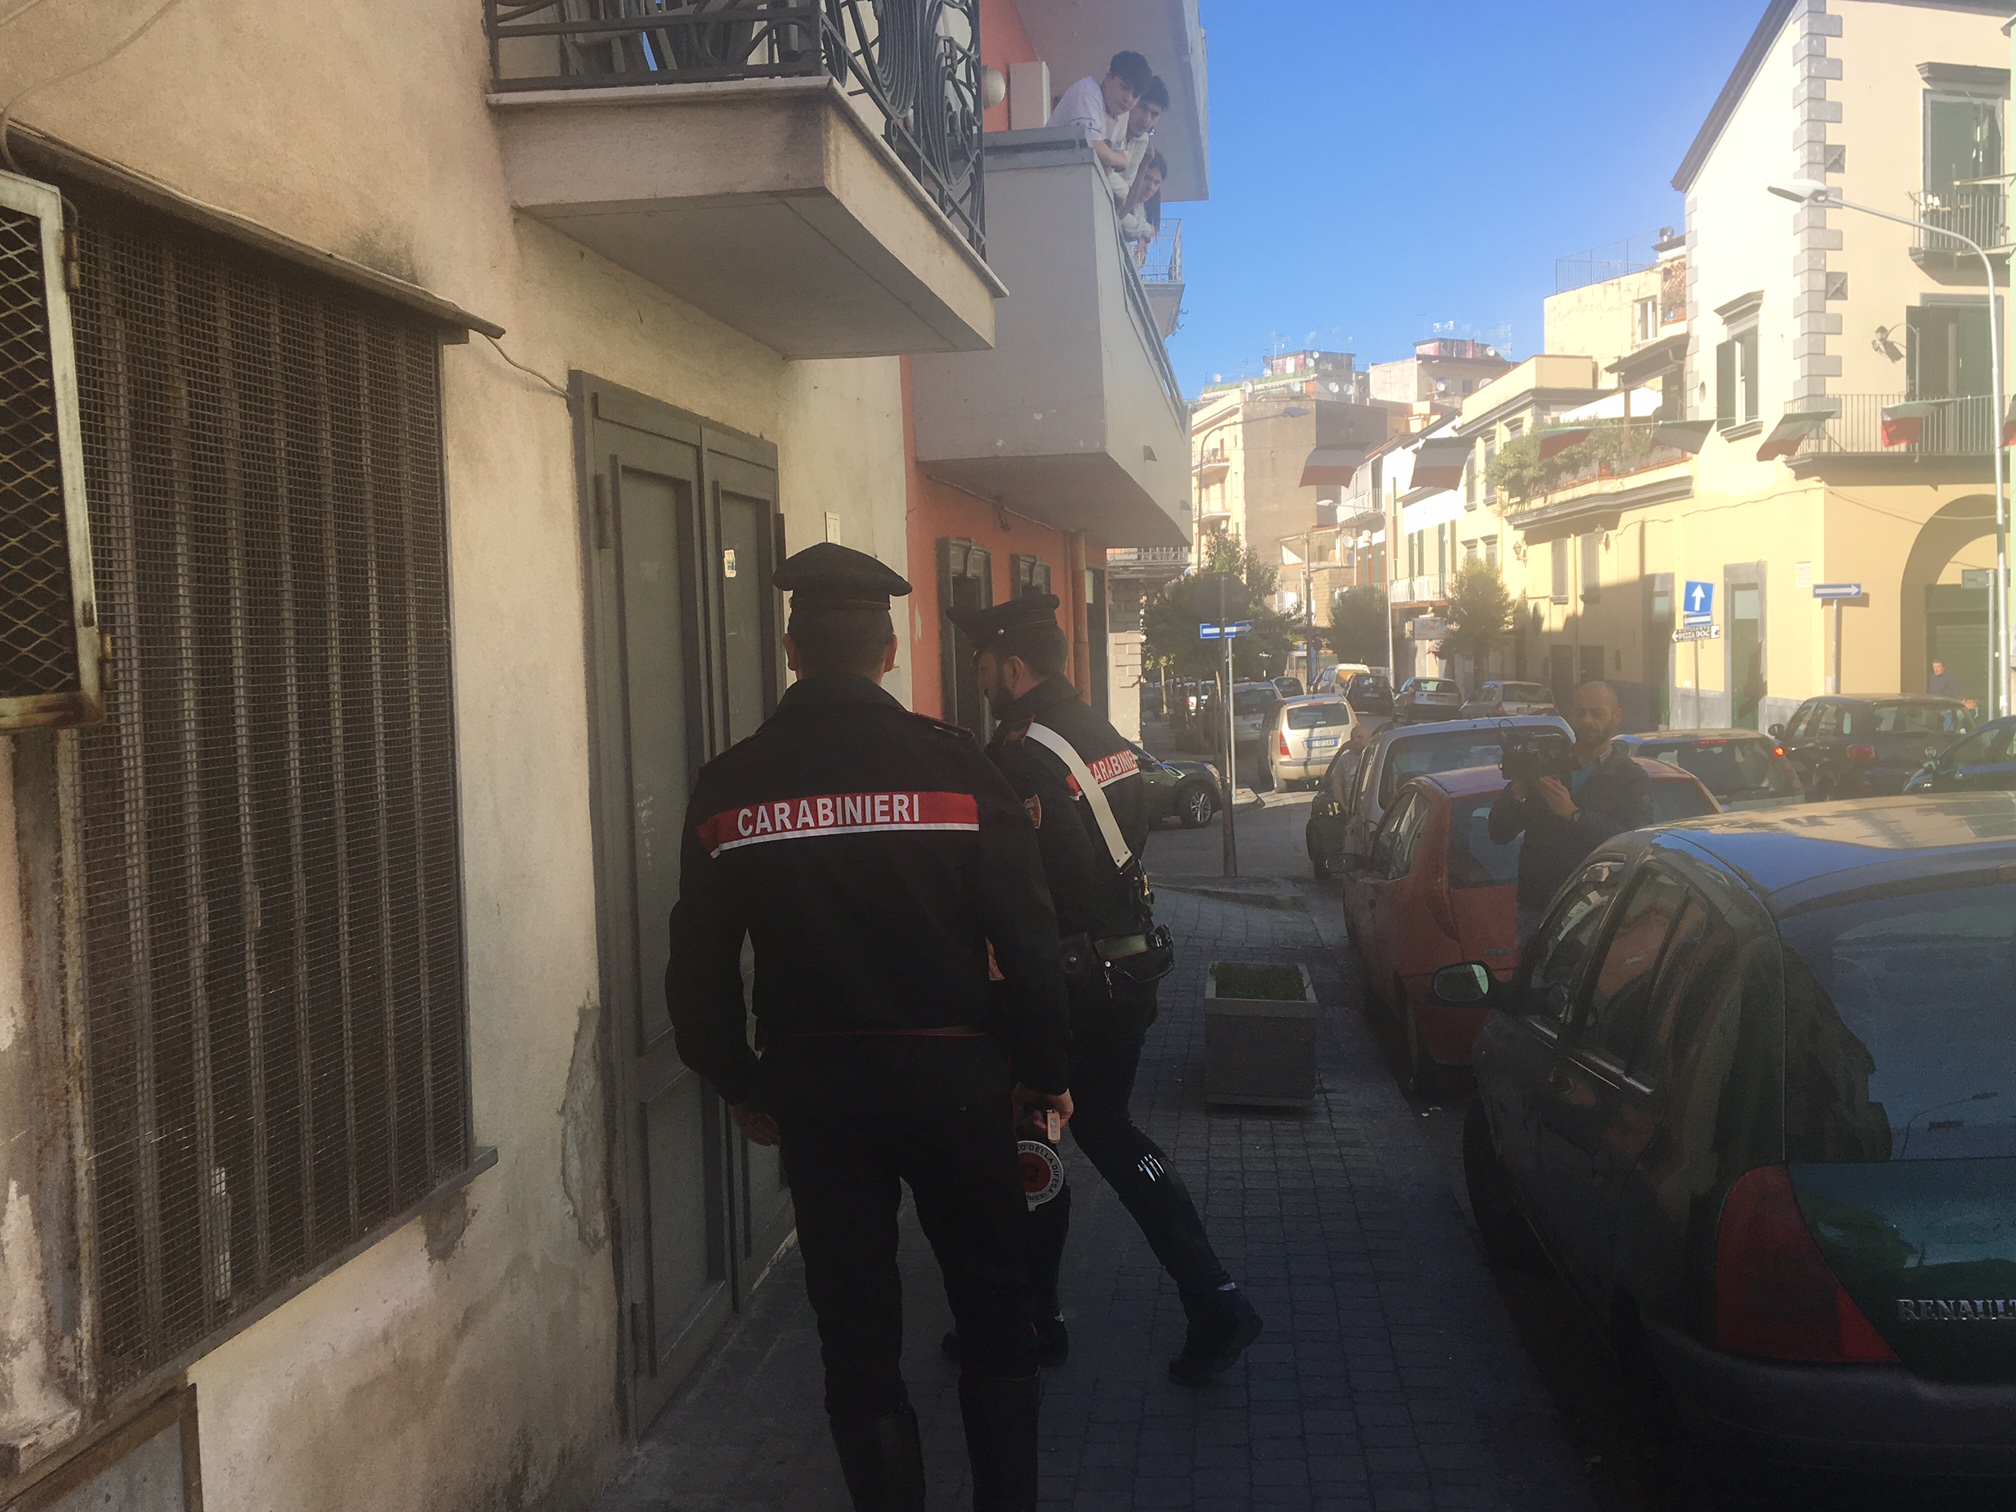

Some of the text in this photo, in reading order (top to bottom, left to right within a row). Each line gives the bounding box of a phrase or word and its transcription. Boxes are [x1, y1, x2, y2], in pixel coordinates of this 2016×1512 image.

[1678, 630, 1710, 640] PIZZA DOC
[737, 793, 919, 837] CARABINIERI
[1028, 1144, 1059, 1193] DELLA DIFESA
